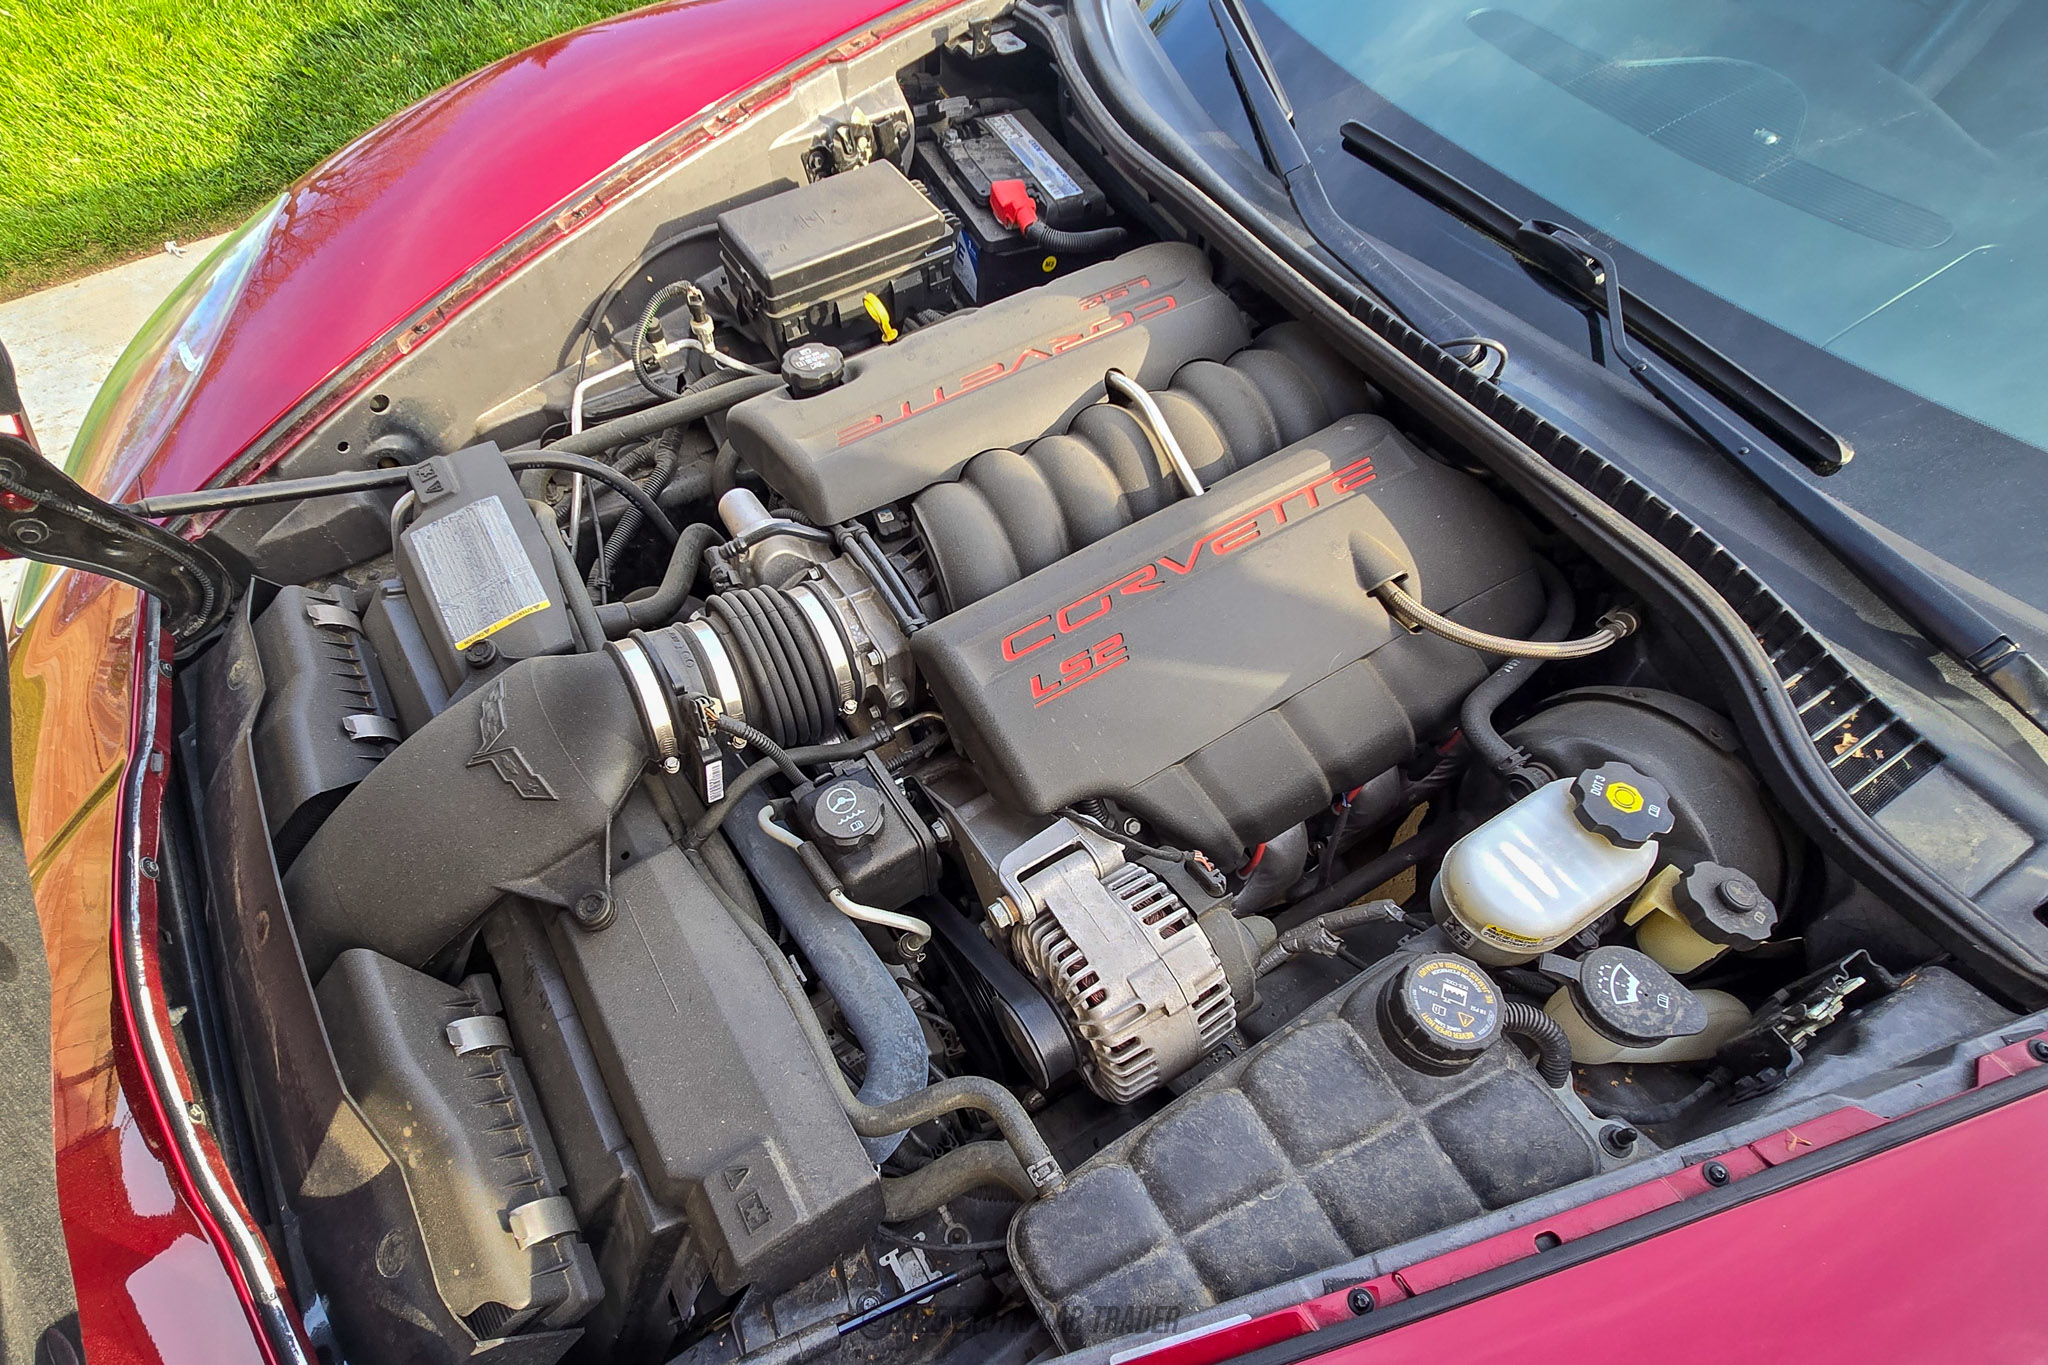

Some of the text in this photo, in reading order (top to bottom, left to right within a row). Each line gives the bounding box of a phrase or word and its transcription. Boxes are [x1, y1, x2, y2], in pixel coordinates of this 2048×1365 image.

[837, 296, 1178, 448] CORVETTE
[1002, 456, 1377, 662] CORVETTE
[1030, 632, 1129, 700] LS2
[1470, 972, 1490, 993] JAMAIS
[1434, 1023, 1452, 1037] OPEN
[1453, 1032, 1475, 1040] NEVER
